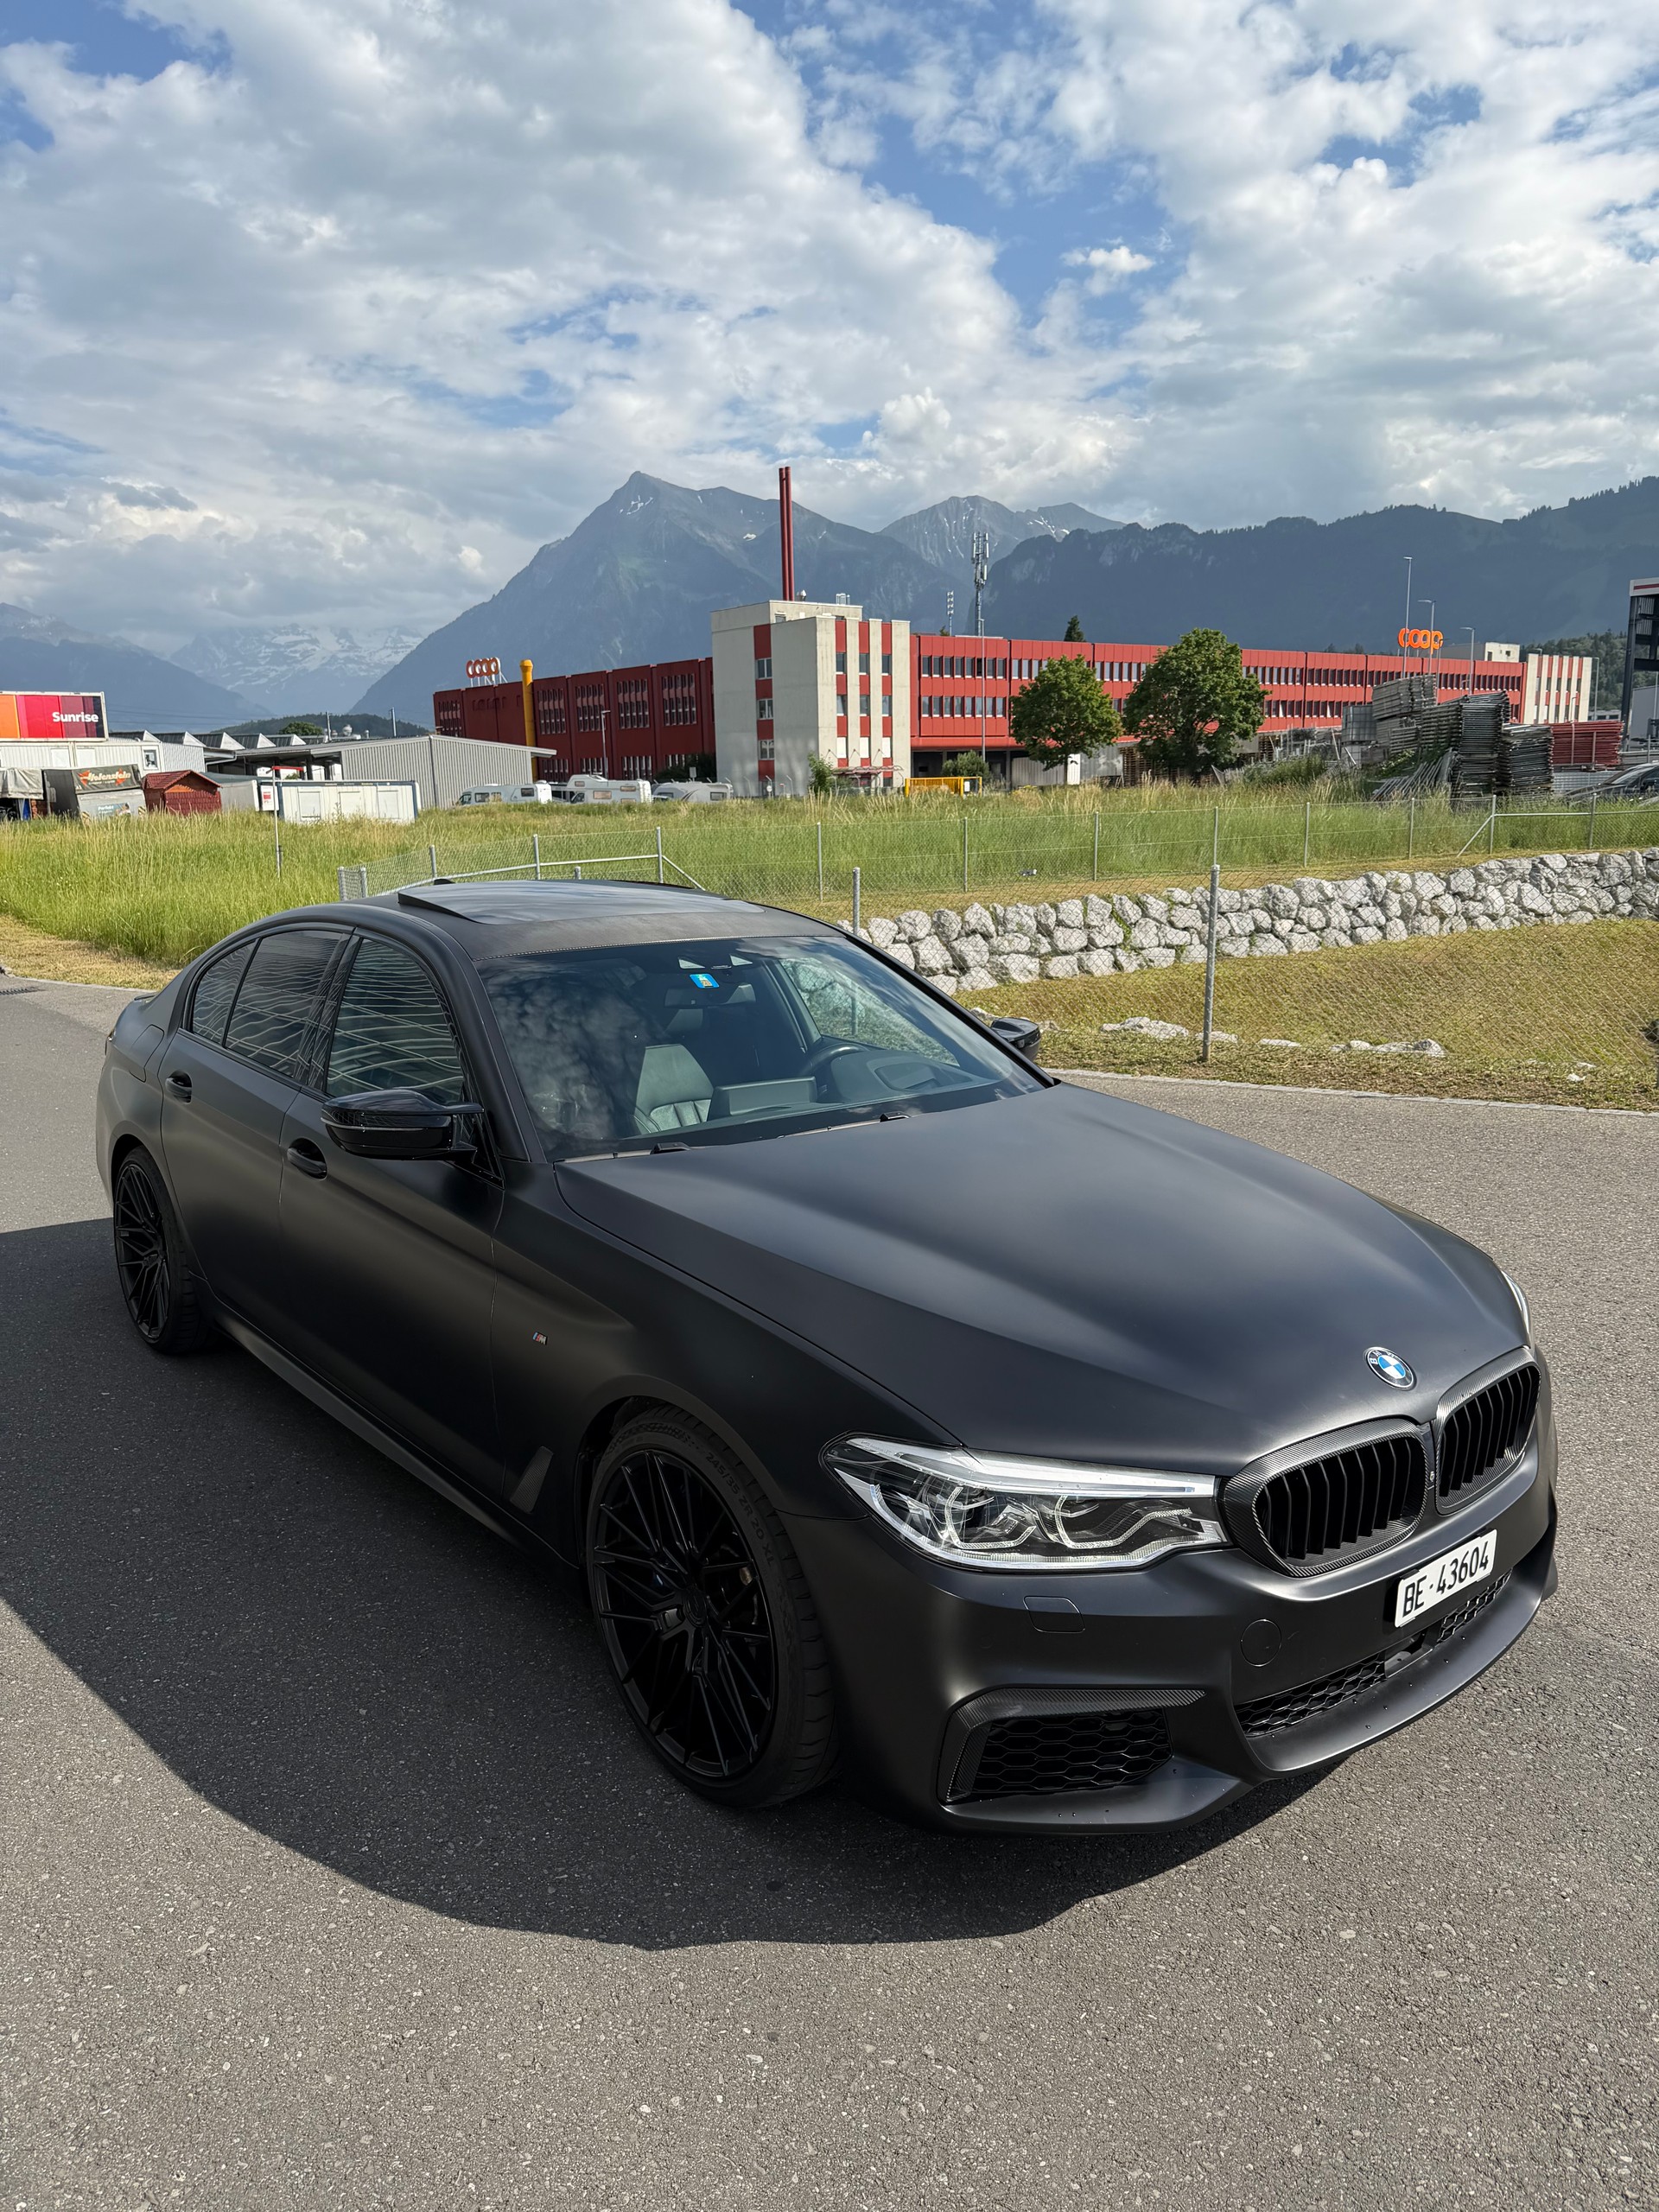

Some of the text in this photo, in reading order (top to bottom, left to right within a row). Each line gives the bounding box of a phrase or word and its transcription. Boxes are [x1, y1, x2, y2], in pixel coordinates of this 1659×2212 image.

[1398, 627, 1443, 655] coop
[52, 711, 99, 722] Sunrise
[706, 1452, 741, 1495] 245/35
[739, 1496, 753, 1516] ZR
[751, 1518, 765, 1540] 20
